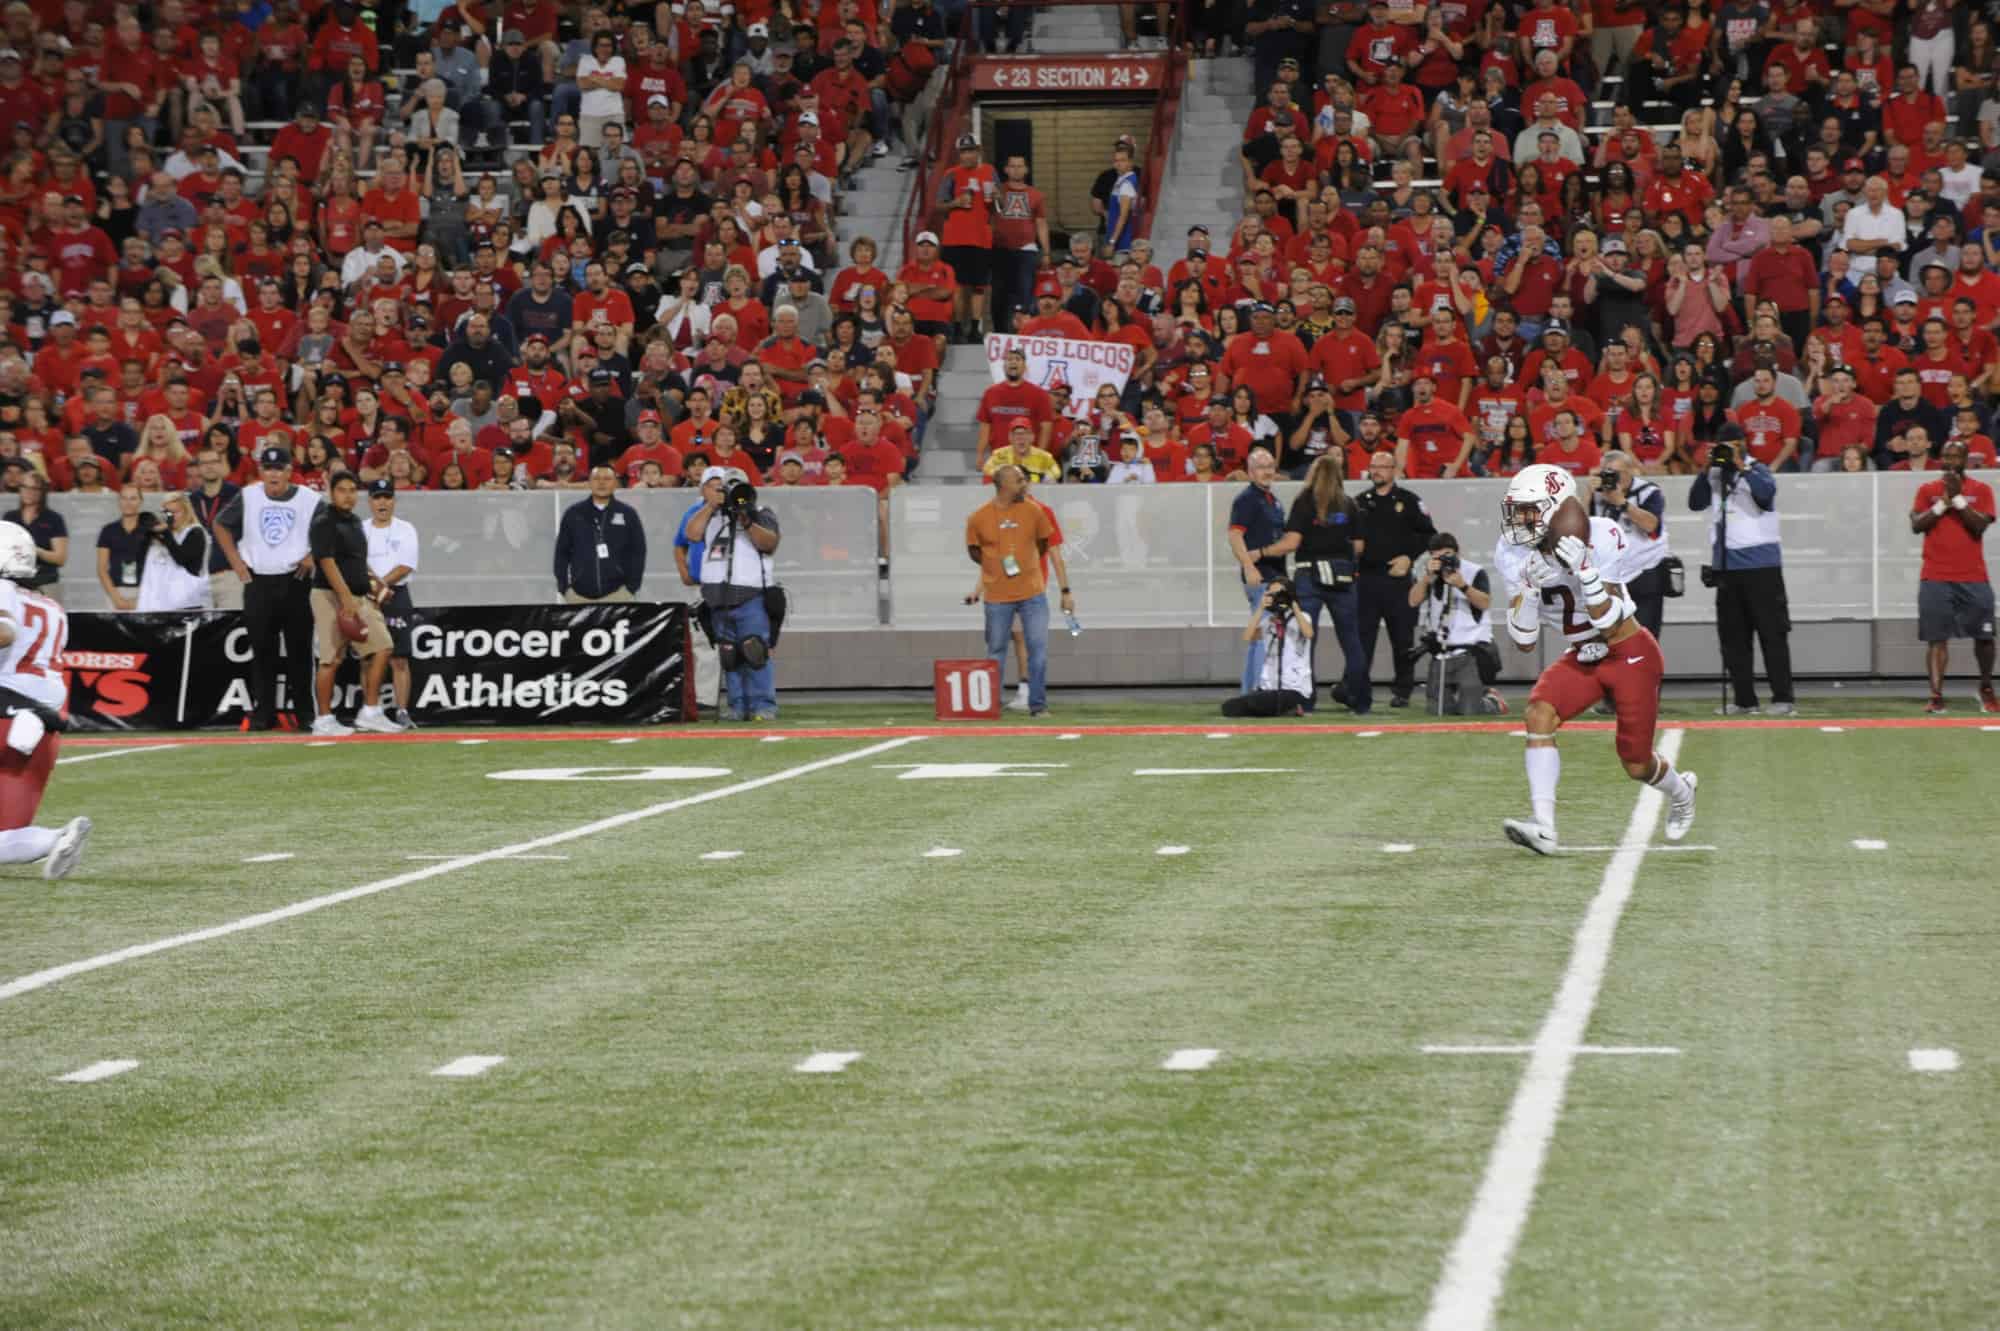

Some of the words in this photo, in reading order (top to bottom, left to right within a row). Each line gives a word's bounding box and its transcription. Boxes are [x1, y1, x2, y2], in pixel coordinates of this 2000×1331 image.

[1011, 67, 1031, 87] 23
[1037, 67, 1105, 87] SECTION
[1111, 67, 1131, 86] 24
[1063, 341, 1131, 374] LOCOS
[1541, 584, 1595, 636] 2
[410, 624, 570, 660] Grocer
[581, 619, 631, 657] of
[416, 672, 629, 708] Athletics
[945, 669, 993, 713] 10
